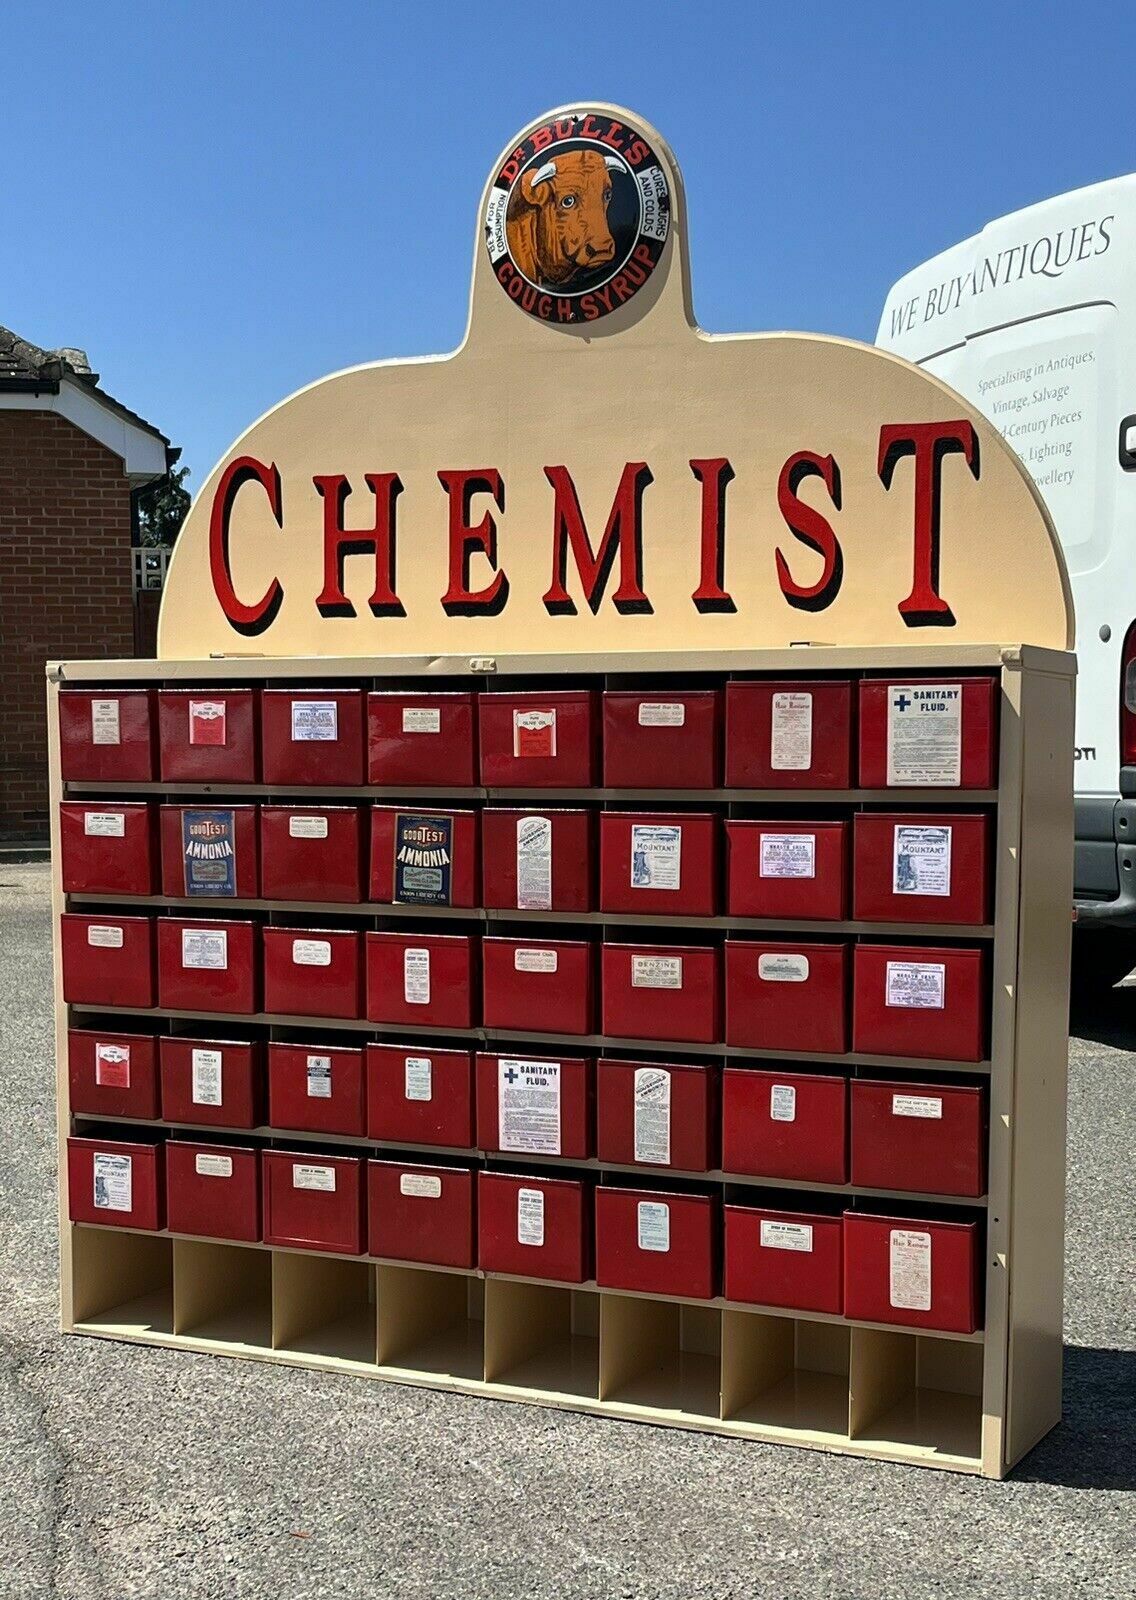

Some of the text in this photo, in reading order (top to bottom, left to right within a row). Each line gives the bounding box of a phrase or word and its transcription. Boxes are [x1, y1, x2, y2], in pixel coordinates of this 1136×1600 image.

[528, 116, 650, 166] BULL'S
[639, 176, 653, 197] AND
[494, 193, 507, 253] CONSUMPTION
[497, 244, 654, 321] COUGH SYRUP
[891, 215, 1115, 339] WE BUY ANTIQUES
[977, 350, 1096, 396] Specialising in Antiques,
[1031, 385, 1070, 402] Salvage
[1050, 411, 1082, 427] Pieces
[1029, 442, 1073, 463] Lighting
[1034, 469, 1075, 486] wellery
[209, 419, 980, 637] CHEMIST
[913, 690, 959, 700] SANITARY
[920, 703, 949, 711] FLUID.
[186, 840, 233, 860] AMMONIA
[397, 845, 450, 867] AMMONIA
[637, 843, 675, 851] MOUNTANT
[902, 844, 945, 854] MOUNTANT
[637, 961, 676, 969] BENZINE
[520, 1065, 558, 1077] SANITARY
[525, 1076, 550, 1087] FLUID.
